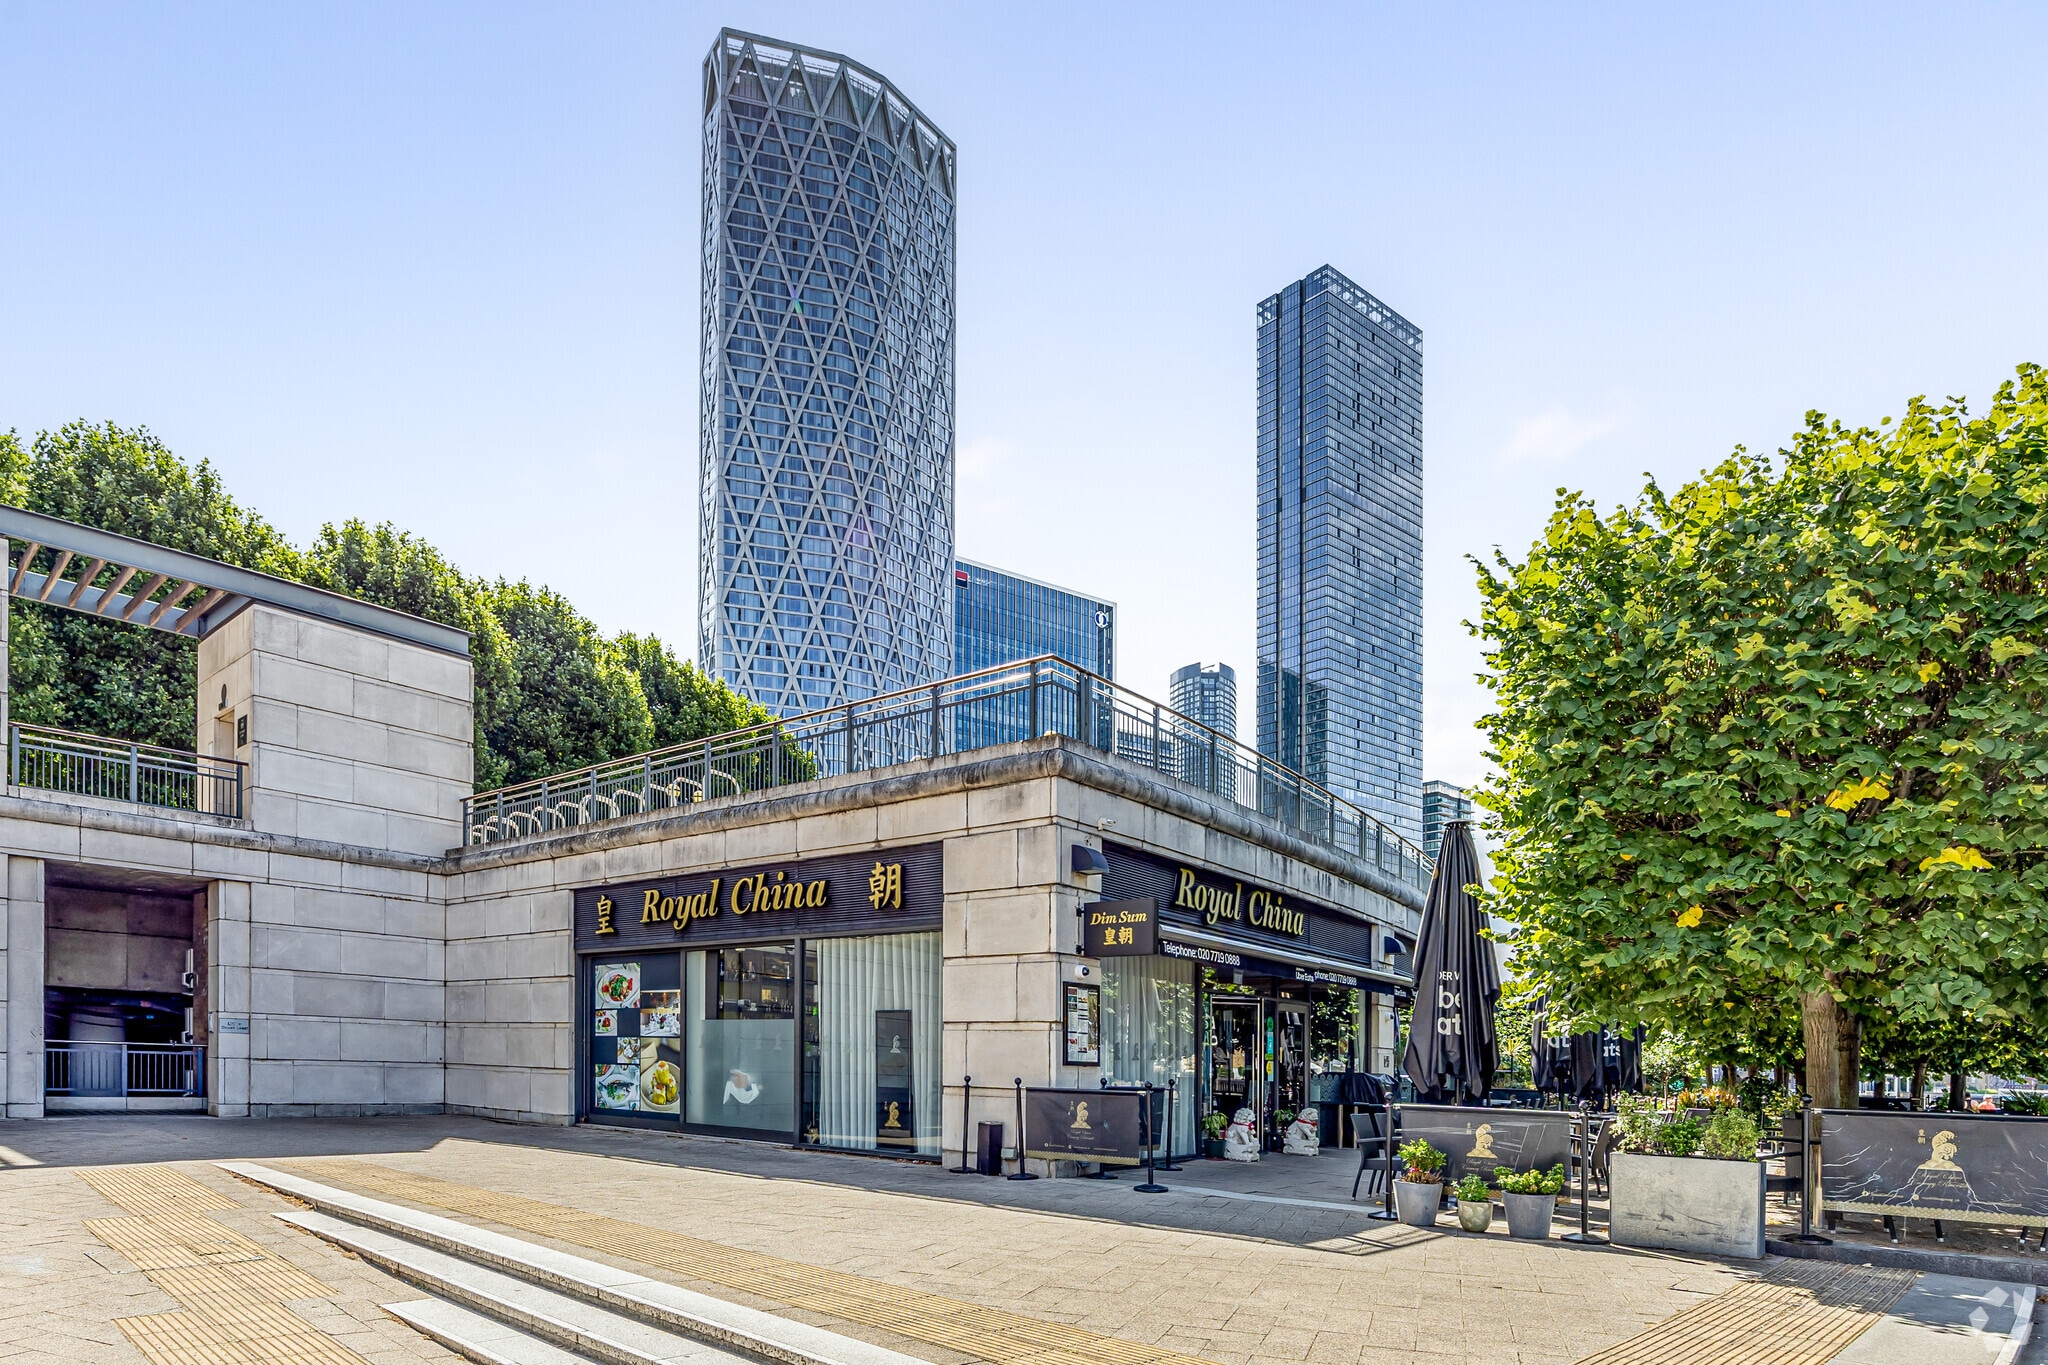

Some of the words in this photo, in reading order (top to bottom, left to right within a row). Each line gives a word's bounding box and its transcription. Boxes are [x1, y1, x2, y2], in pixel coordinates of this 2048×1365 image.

[594, 894, 615, 934] 皇
[640, 878, 720, 930] Royal
[731, 870, 827, 915] China
[868, 861, 902, 910] 朝
[1175, 868, 1242, 926] Royal
[1249, 890, 1305, 936] China
[1090, 911, 1117, 926] Dim
[1118, 910, 1148, 924] Sum
[1103, 926, 1133, 946] 皇朝
[1162, 941, 1198, 958] Telephone:
[1198, 947, 1210, 960] 020
[1210, 950, 1225, 964] 7719
[1225, 953, 1241, 966] 0888
